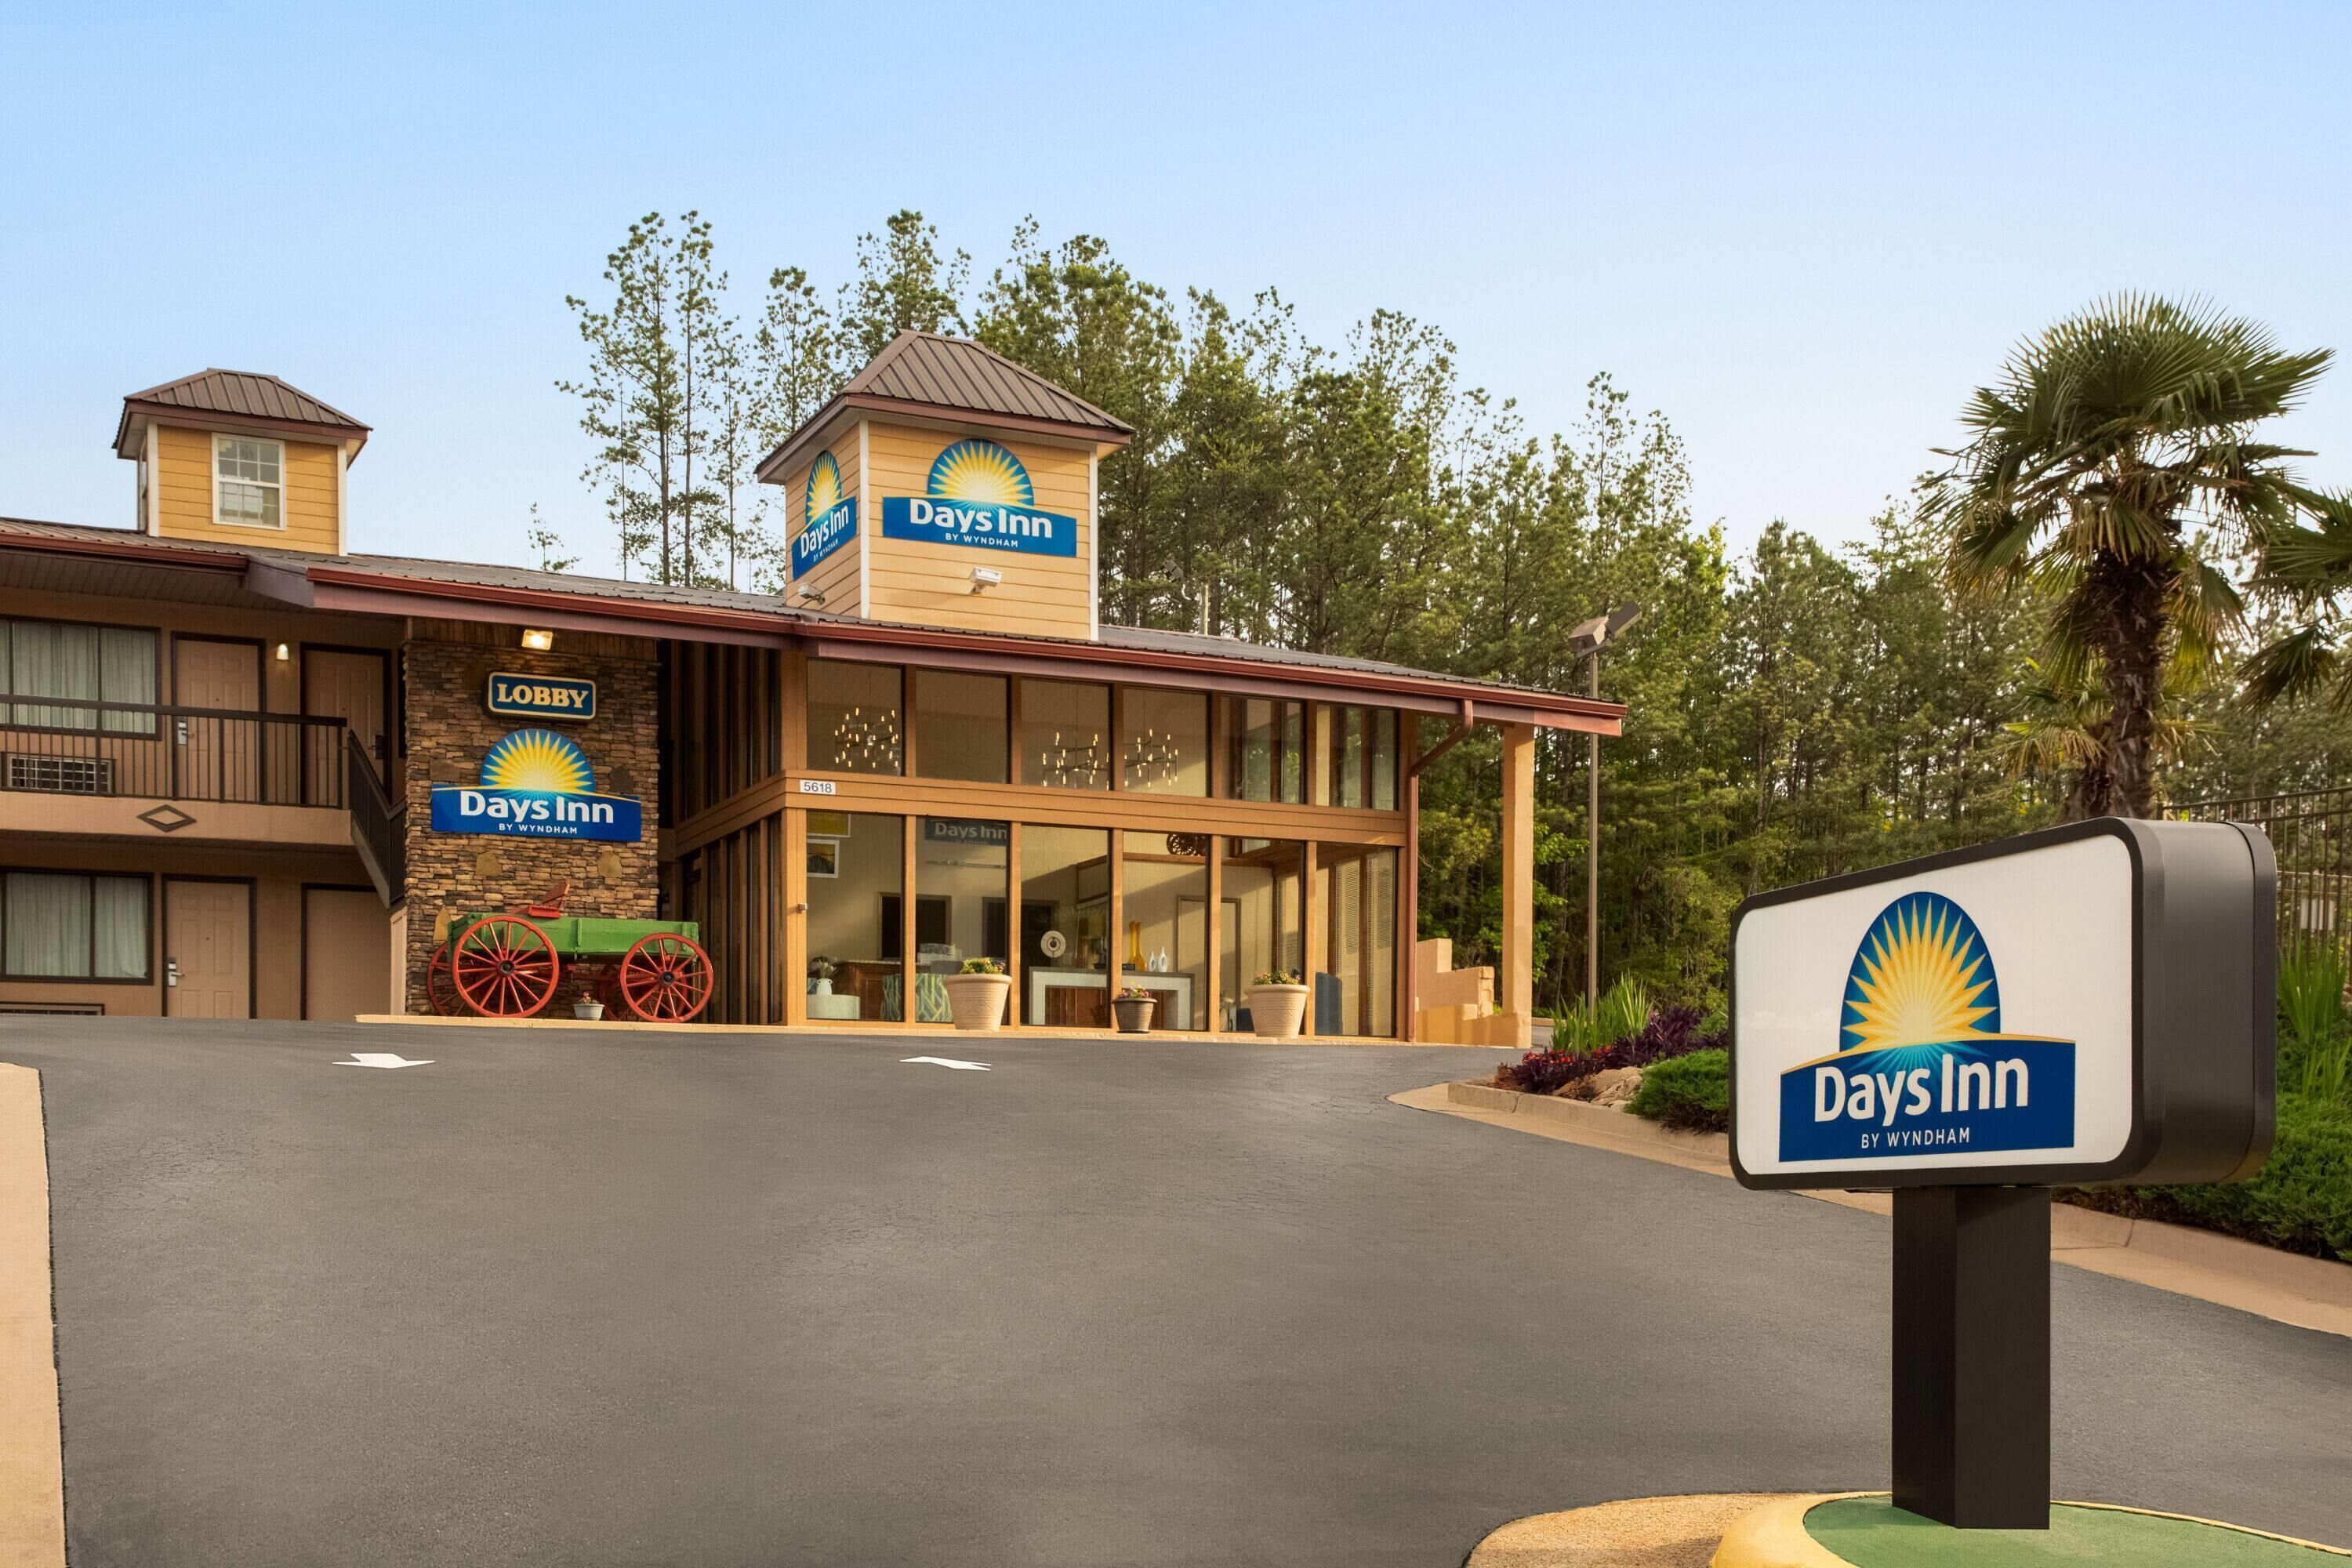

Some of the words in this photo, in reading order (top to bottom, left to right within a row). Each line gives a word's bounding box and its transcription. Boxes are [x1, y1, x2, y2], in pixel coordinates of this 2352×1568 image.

[909, 498, 993, 532] Days
[998, 510, 1052, 539] Inn
[800, 520, 829, 559] Days
[830, 505, 849, 537] Inn
[945, 532, 959, 542] BY
[963, 535, 1018, 548] WYNDHAM
[496, 683, 589, 709] LOBBY
[803, 781, 833, 793] 5618
[459, 789, 550, 822] Days
[556, 796, 614, 824] Inn
[499, 823, 513, 832] BY
[518, 824, 578, 835] WYNDHAM
[935, 822, 978, 838] Days
[981, 825, 1007, 840] Inn
[1813, 1065, 1931, 1127] Days
[1940, 1053, 2029, 1113] Inn
[1860, 1133, 1880, 1149] BY
[1886, 1127, 1970, 1147] WYNDHAM
